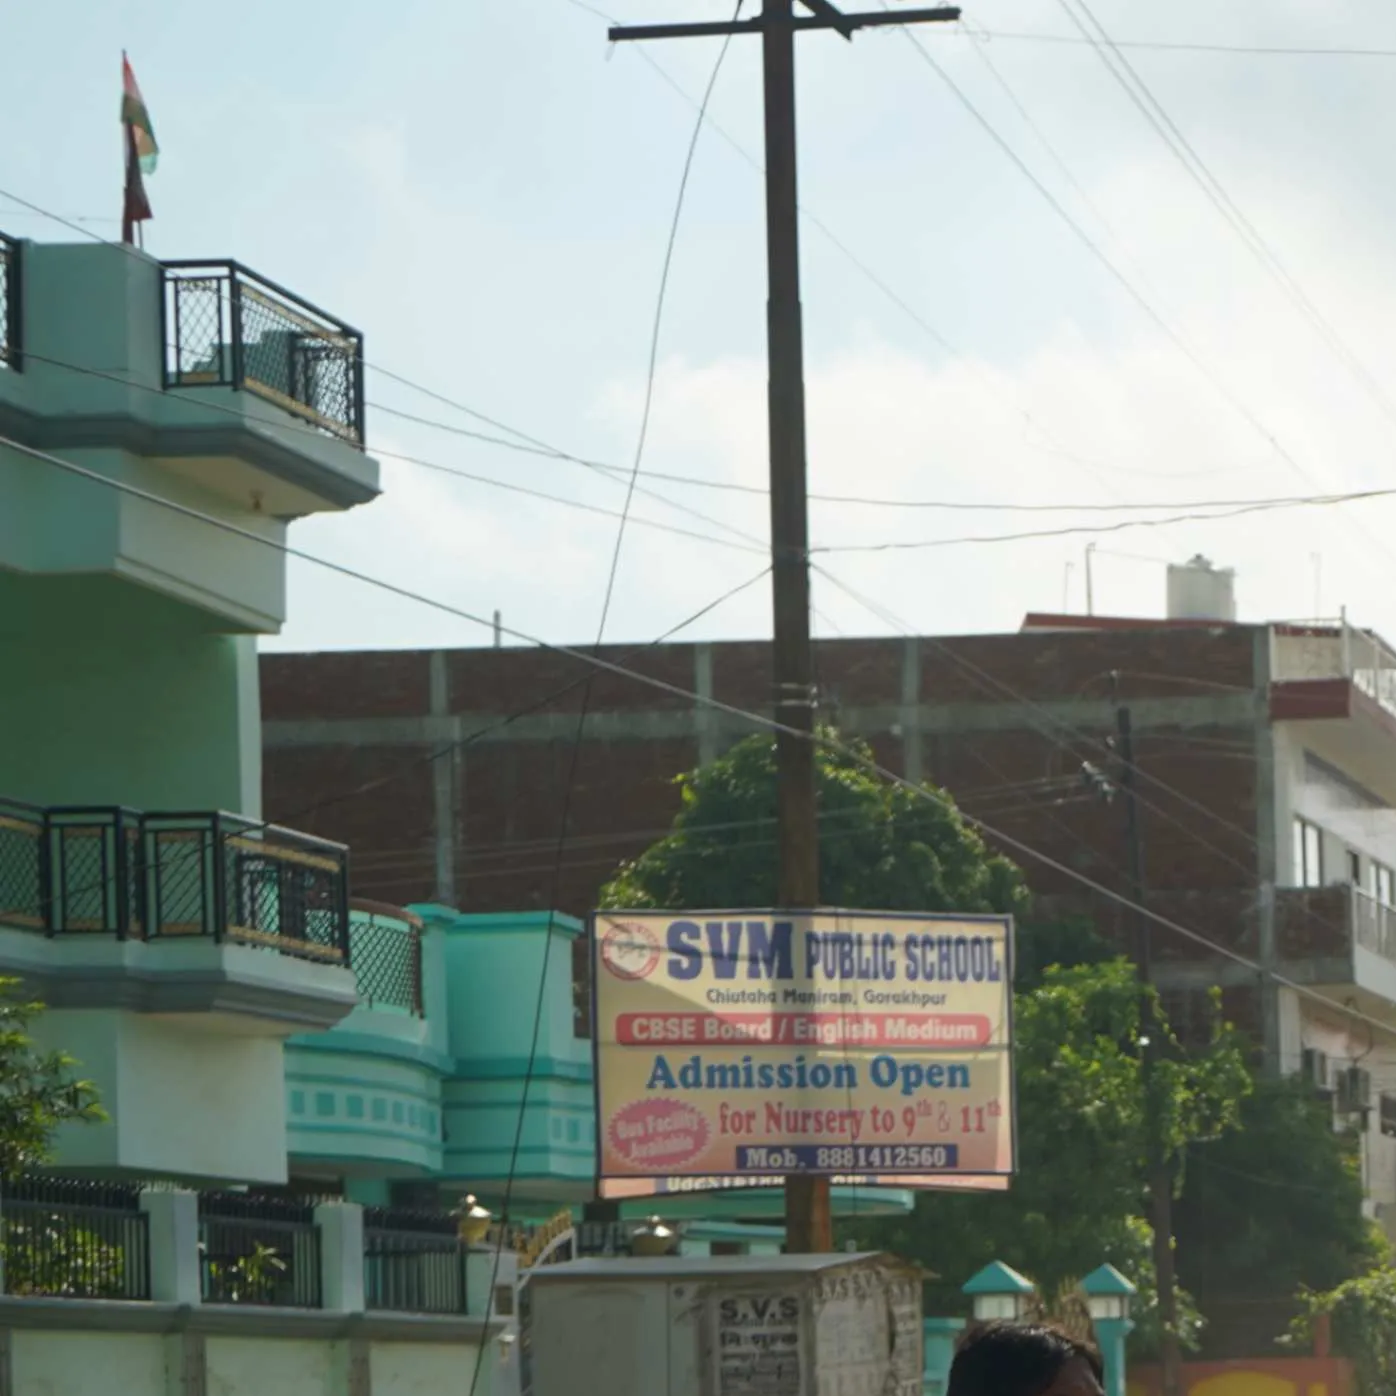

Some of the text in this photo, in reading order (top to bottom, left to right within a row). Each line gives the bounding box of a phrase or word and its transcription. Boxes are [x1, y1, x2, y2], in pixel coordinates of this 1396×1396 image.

[666, 920, 794, 981] SVM
[805, 930, 896, 981] PUBLIC
[904, 933, 1001, 982] SCHOOL
[863, 989, 948, 1009] Gorakhpur
[631, 1016, 697, 1041] CBSE
[703, 1017, 773, 1042] Board
[793, 1016, 878, 1044] English
[884, 1017, 978, 1041] Medium
[646, 1055, 971, 1096] Admission Open
[719, 1101, 757, 1135] for
[764, 1101, 865, 1140] Nursery
[870, 1104, 896, 1134] to
[745, 1146, 947, 1169] Mob. 8881412560
[721, 1297, 799, 1321] S.V.S
